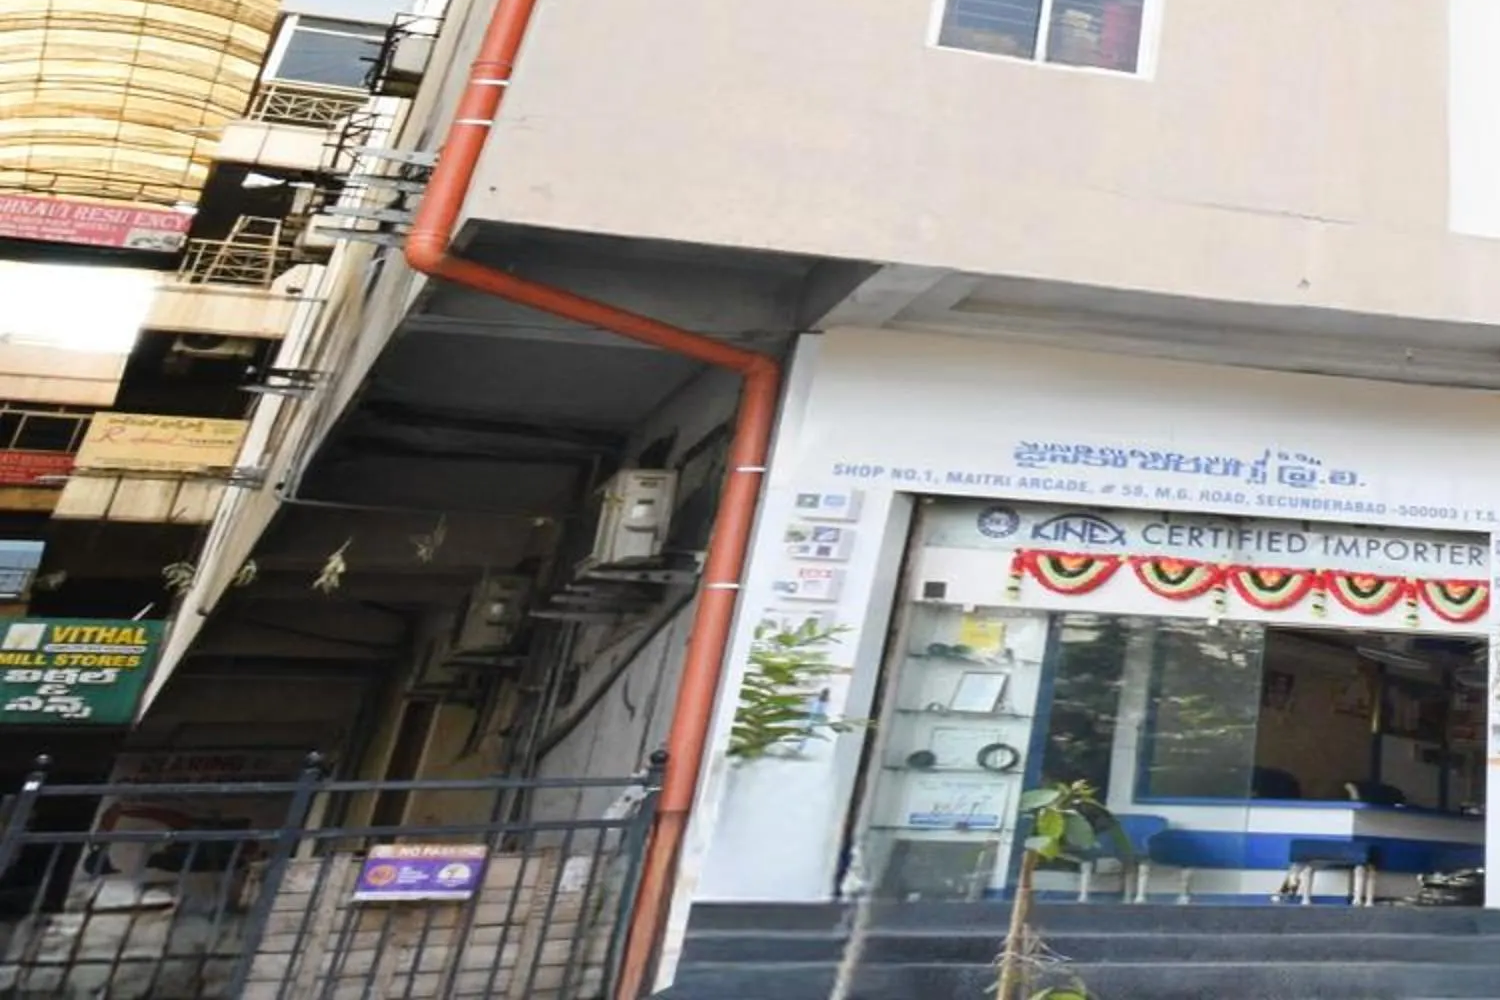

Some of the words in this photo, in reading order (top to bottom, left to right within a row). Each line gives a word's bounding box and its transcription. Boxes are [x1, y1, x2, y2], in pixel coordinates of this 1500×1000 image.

[833, 462, 885, 479] SHOP
[946, 471, 1011, 488] MAITRI
[1255, 493, 1387, 516] SECUNDERABAD
[1031, 513, 1127, 546] KINEX
[1142, 522, 1308, 554] CERTIFIED
[1323, 534, 1486, 567] IMPORTER
[53, 626, 148, 644] VITHAL
[54, 654, 141, 667] STORES
